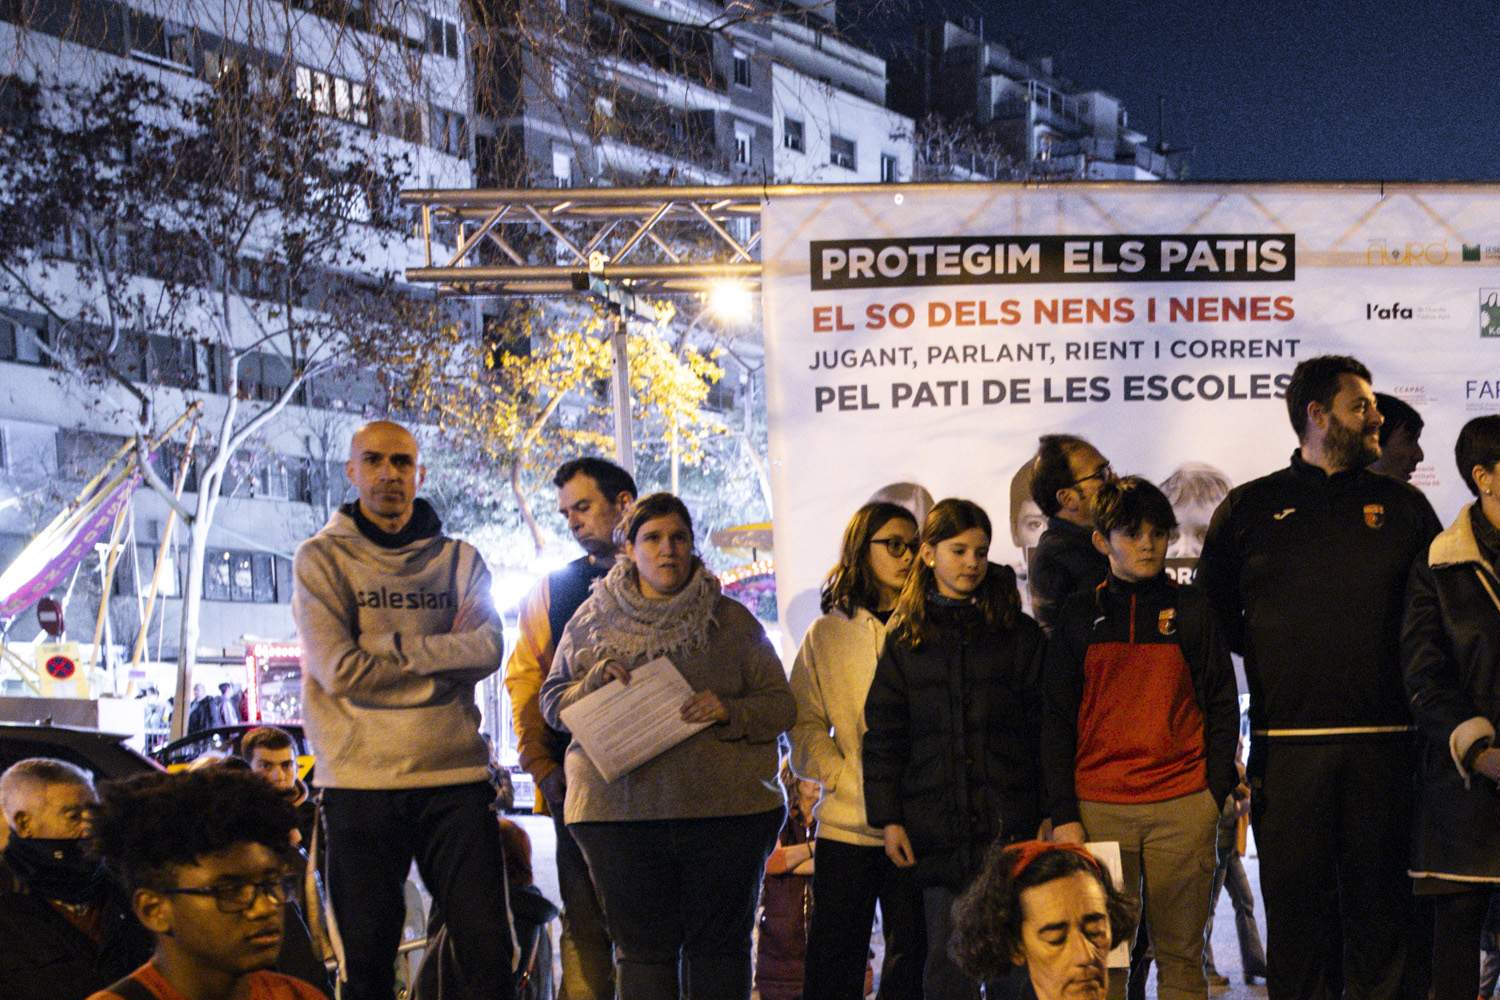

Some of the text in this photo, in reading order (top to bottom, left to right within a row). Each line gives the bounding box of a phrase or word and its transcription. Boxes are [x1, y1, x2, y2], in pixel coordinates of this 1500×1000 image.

[822, 239, 1288, 281] PROTEGIM ELS PATIS
[813, 295, 1295, 333] EL SO DELS NENS I NENES
[1366, 302, 1414, 320] l'afa
[809, 339, 1301, 370] JUGANT, PARLANT, RIENT I CORRENT
[815, 374, 1296, 413] PEL PATI DE LES ESCOLES
[357, 586, 452, 610] salesian
